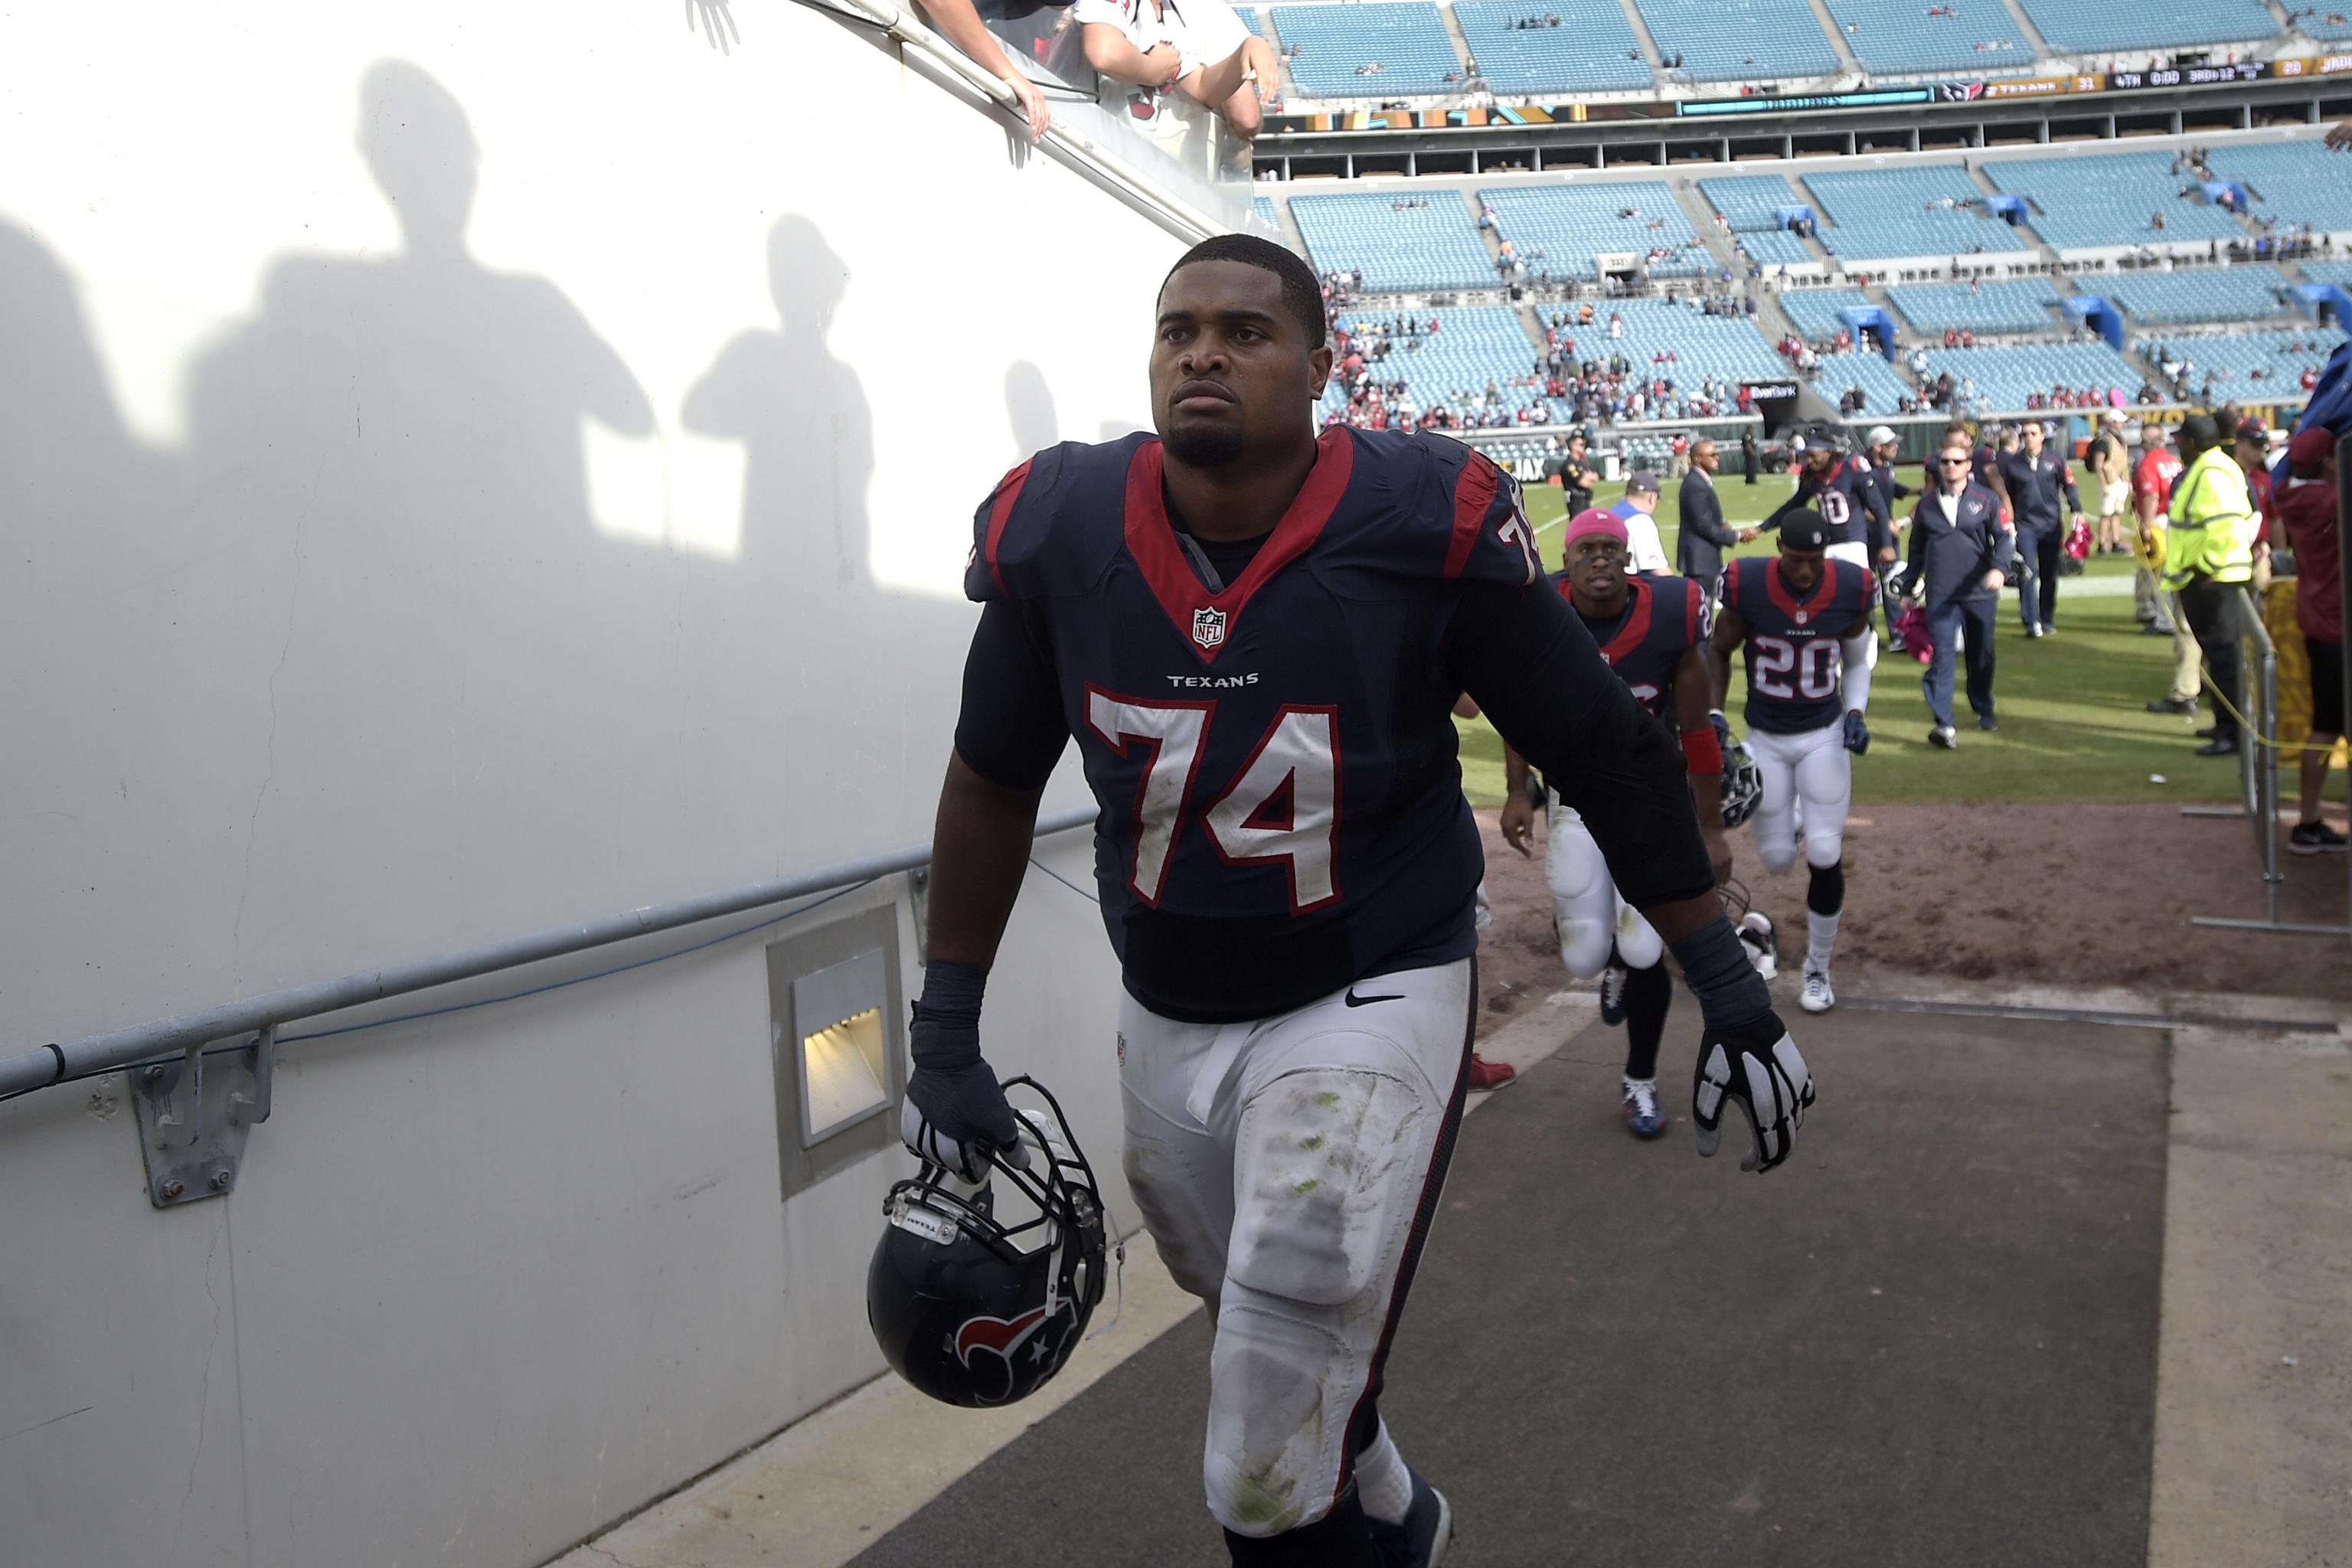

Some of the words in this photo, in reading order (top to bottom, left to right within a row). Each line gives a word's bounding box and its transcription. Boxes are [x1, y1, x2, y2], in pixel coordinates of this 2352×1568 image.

[2078, 77, 2095, 90] 31
[2115, 74, 2141, 88] 4TH
[2150, 70, 2180, 86] 0:00
[1749, 385, 1796, 399] EverBank
[1512, 459, 1545, 482] JAX
[1197, 624, 1219, 641] NFL
[1754, 636, 1841, 700] 20
[1166, 673, 1259, 688] TEXANS
[1084, 681, 1344, 917] 74
